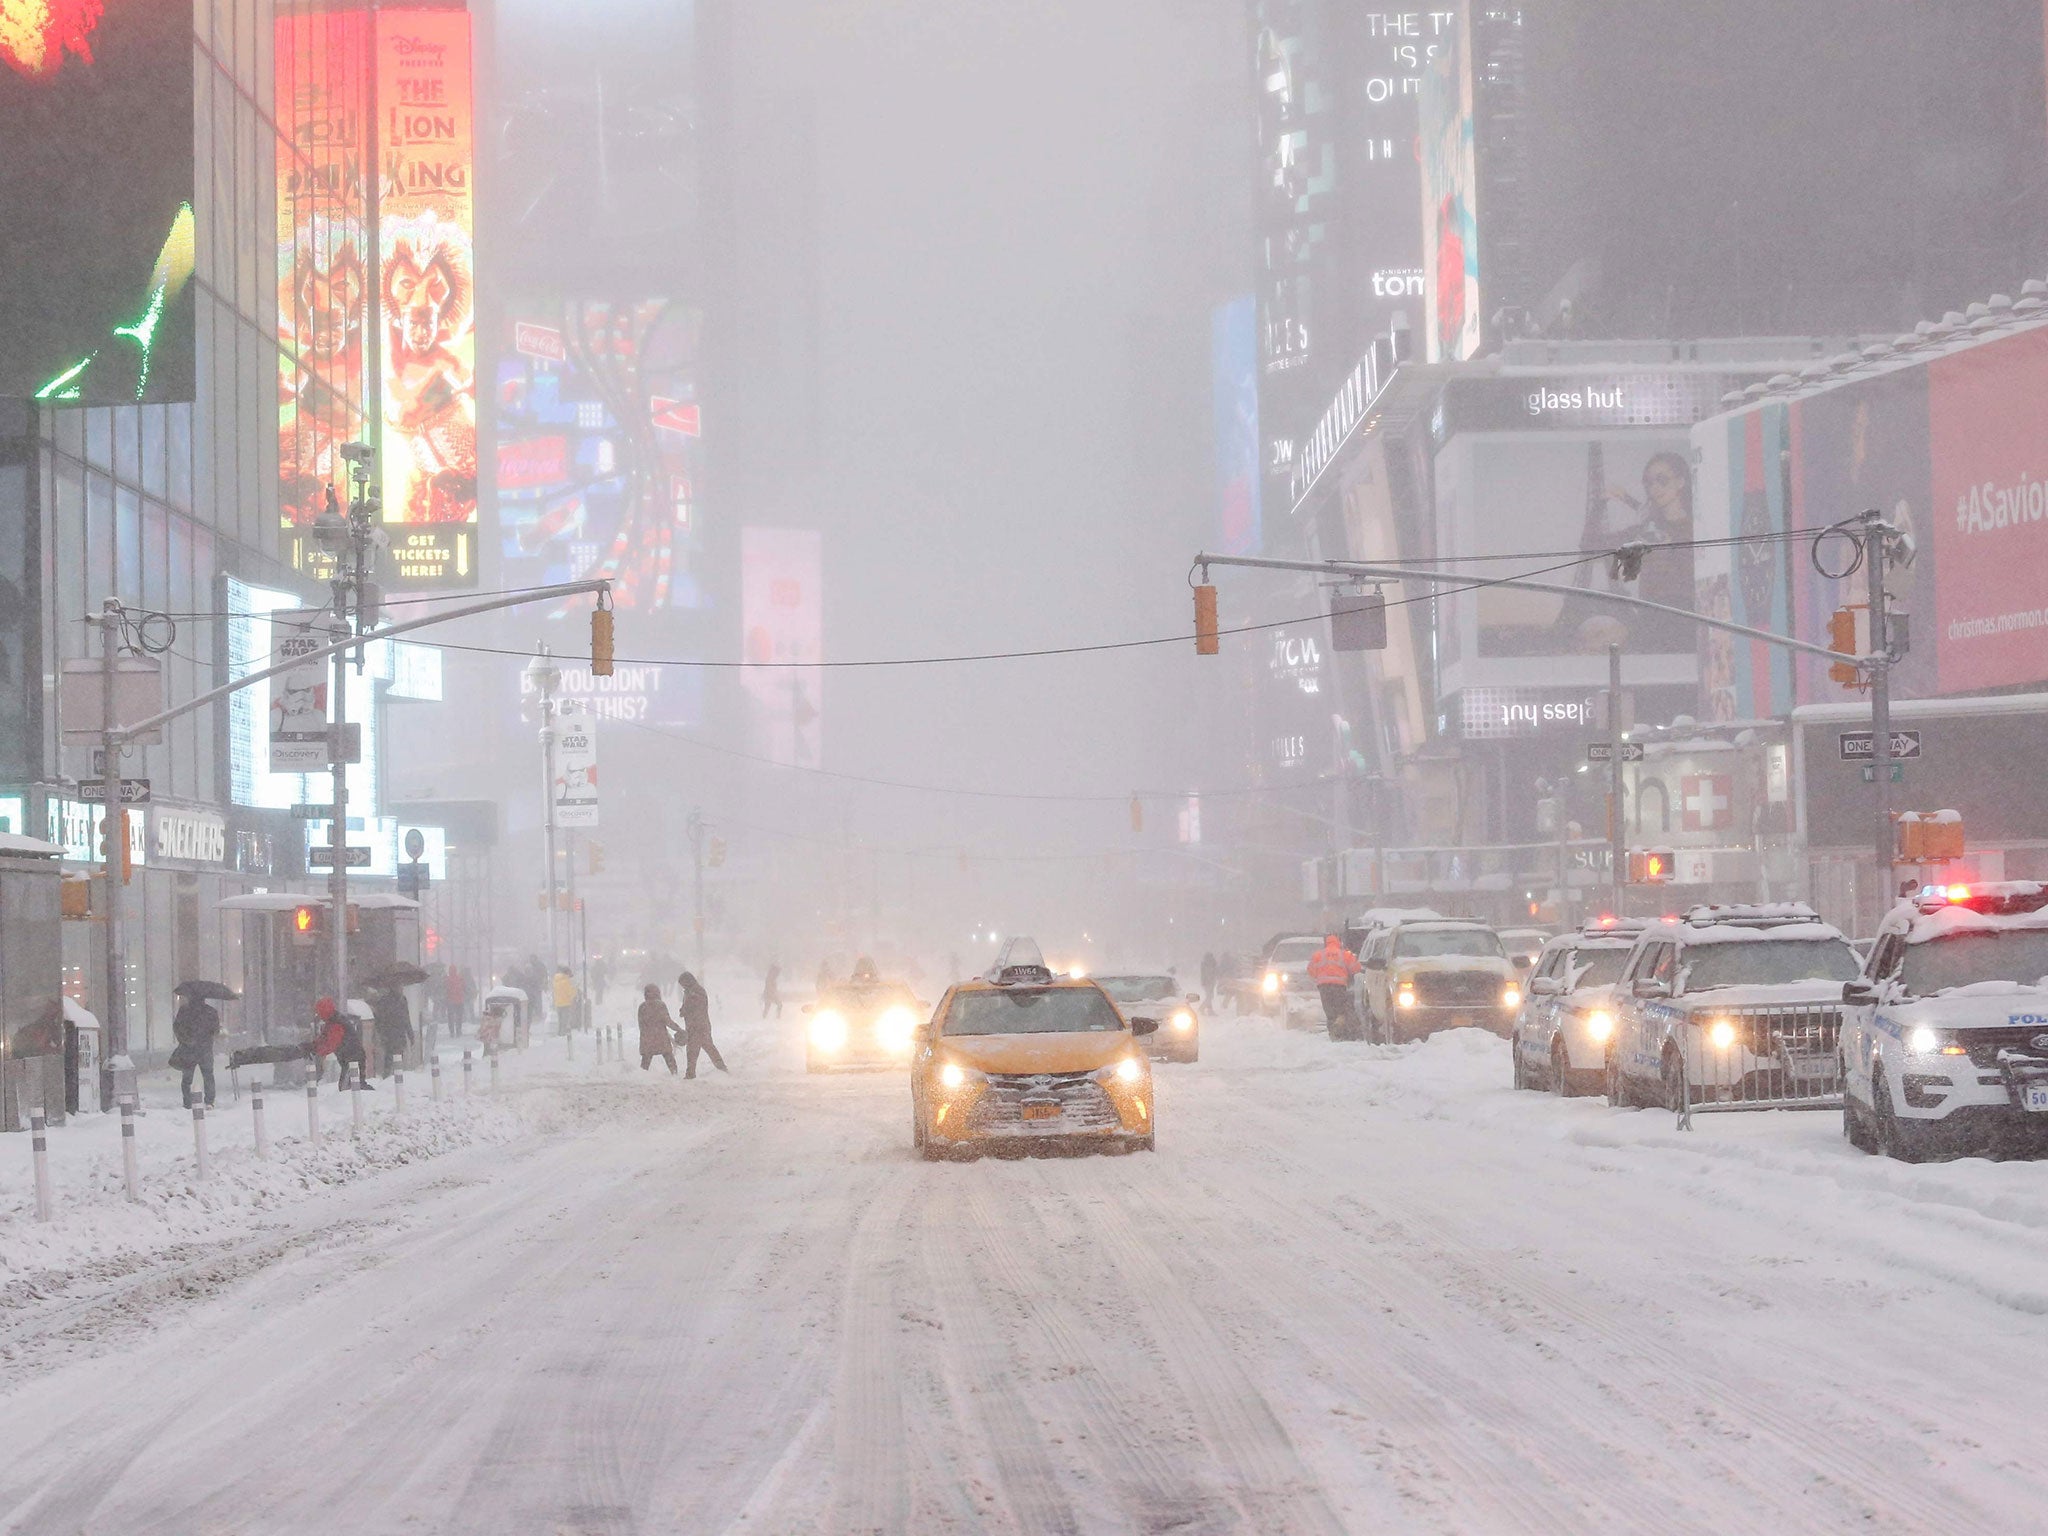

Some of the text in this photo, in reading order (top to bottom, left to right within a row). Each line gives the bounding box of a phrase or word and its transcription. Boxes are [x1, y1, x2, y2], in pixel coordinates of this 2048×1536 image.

[1367, 13, 1419, 36] THE
[398, 79, 443, 101] THE
[390, 106, 455, 147] LION
[386, 151, 466, 197] KING
[1321, 340, 1378, 464] BROADWAY
[1587, 386, 1623, 408] hut
[408, 535, 435, 546] GET
[393, 549, 449, 560] TICKETS
[401, 565, 442, 577] HERE!
[281, 638, 319, 648] STAR
[560, 669, 594, 692] YOU
[595, 697, 648, 720] THIS?
[1501, 703, 1537, 726] hut
[1847, 741, 1871, 752] ONE
[158, 815, 225, 862] SKECHERS
